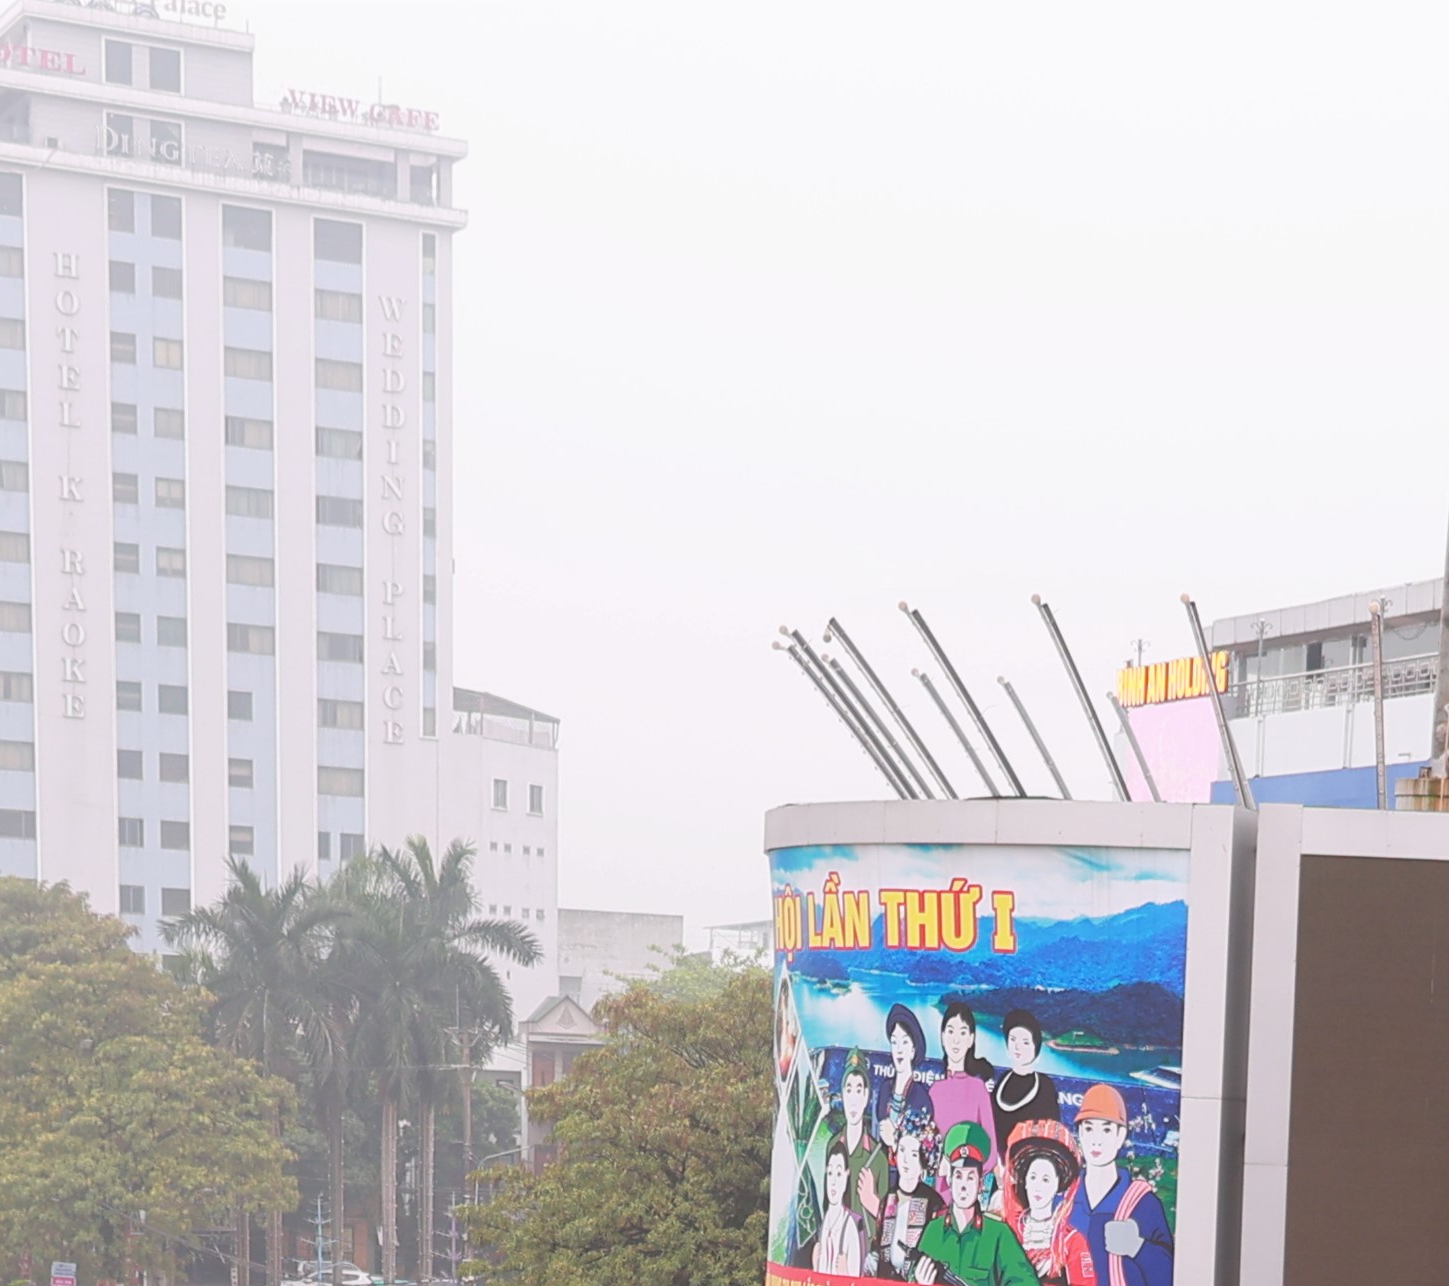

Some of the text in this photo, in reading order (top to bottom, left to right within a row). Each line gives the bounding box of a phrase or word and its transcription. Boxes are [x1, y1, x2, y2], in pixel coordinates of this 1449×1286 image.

[287, 88, 441, 131] VIEW CAFE
[52, 252, 82, 429] HOTEL
[379, 295, 406, 745] WEDDING PLACE
[806, 871, 872, 950] LẦN
[879, 878, 983, 953] THỨ
[992, 890, 1016, 953] I
